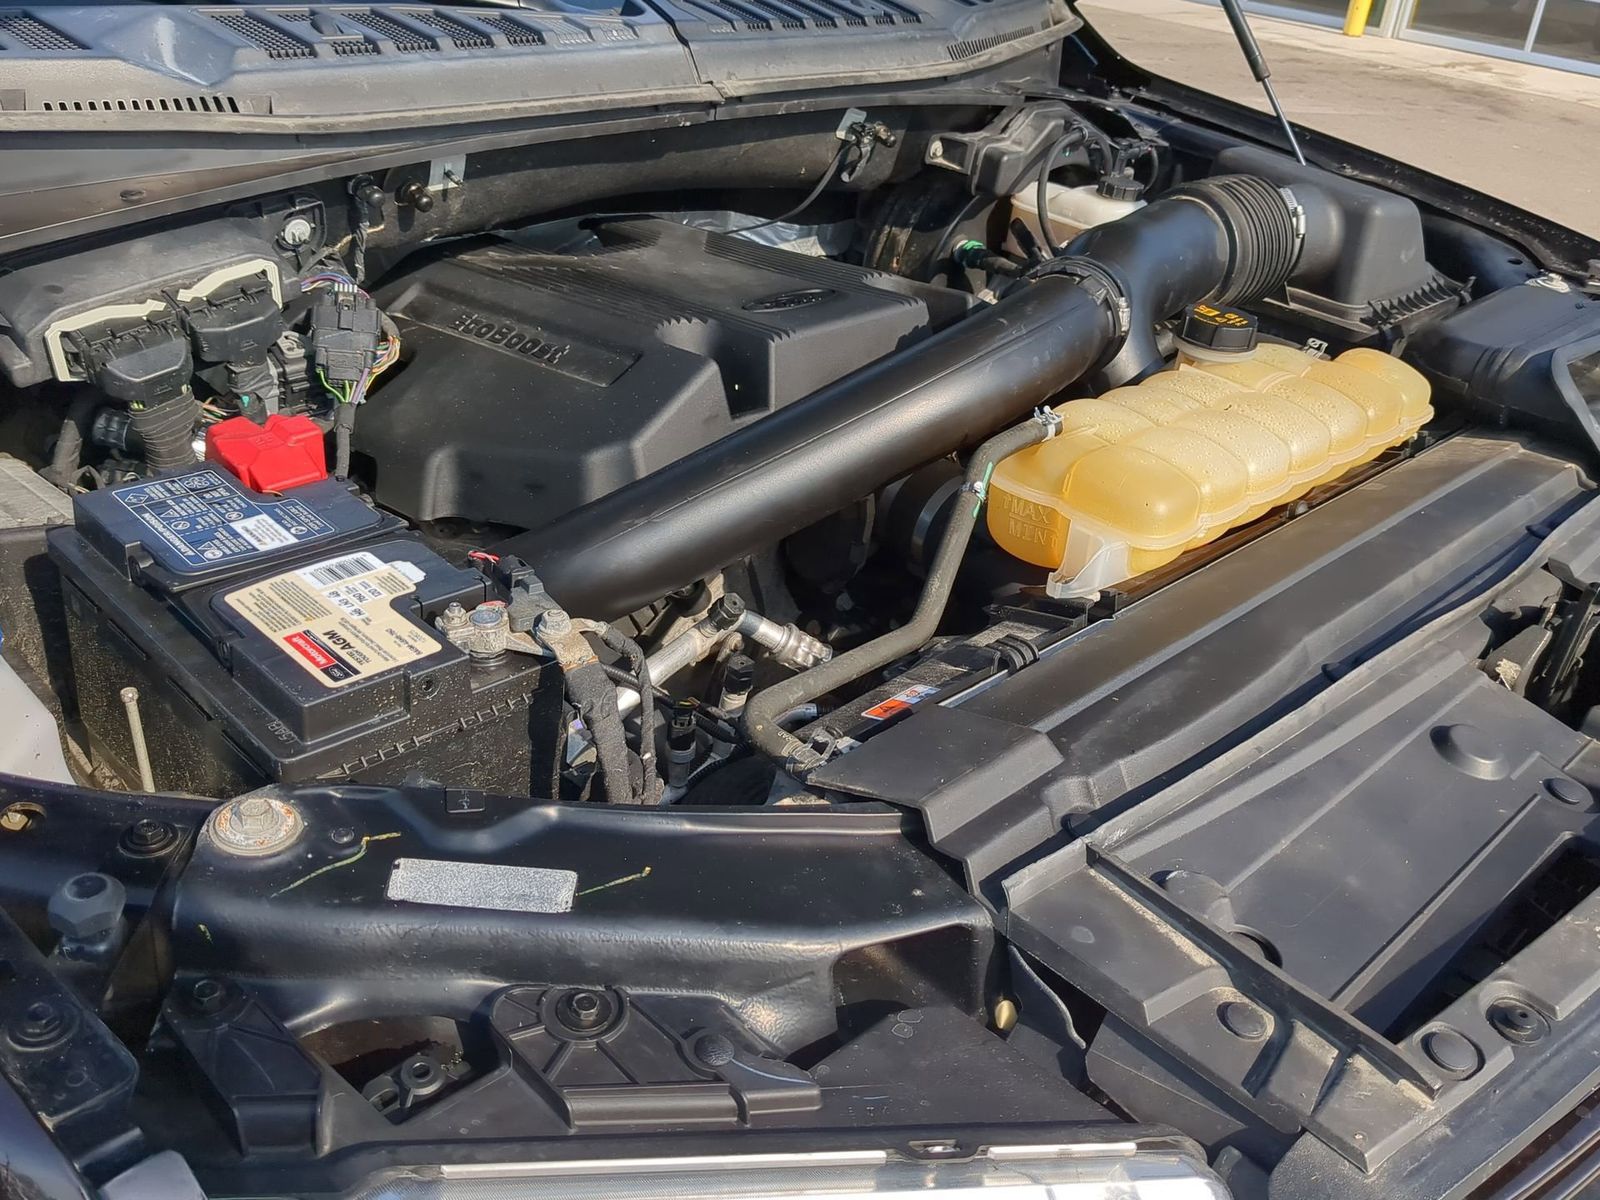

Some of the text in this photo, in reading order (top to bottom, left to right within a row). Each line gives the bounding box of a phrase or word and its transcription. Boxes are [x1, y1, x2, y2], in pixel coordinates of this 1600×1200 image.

[1010, 496, 1052, 524] MAX
[1008, 517, 1048, 546] MIN
[328, 590, 366, 617] H6 LN3 48
[352, 592, 369, 603] 760
[369, 588, 383, 598] 120
[291, 636, 327, 665] Motorcraft
[322, 629, 356, 650] AGM
